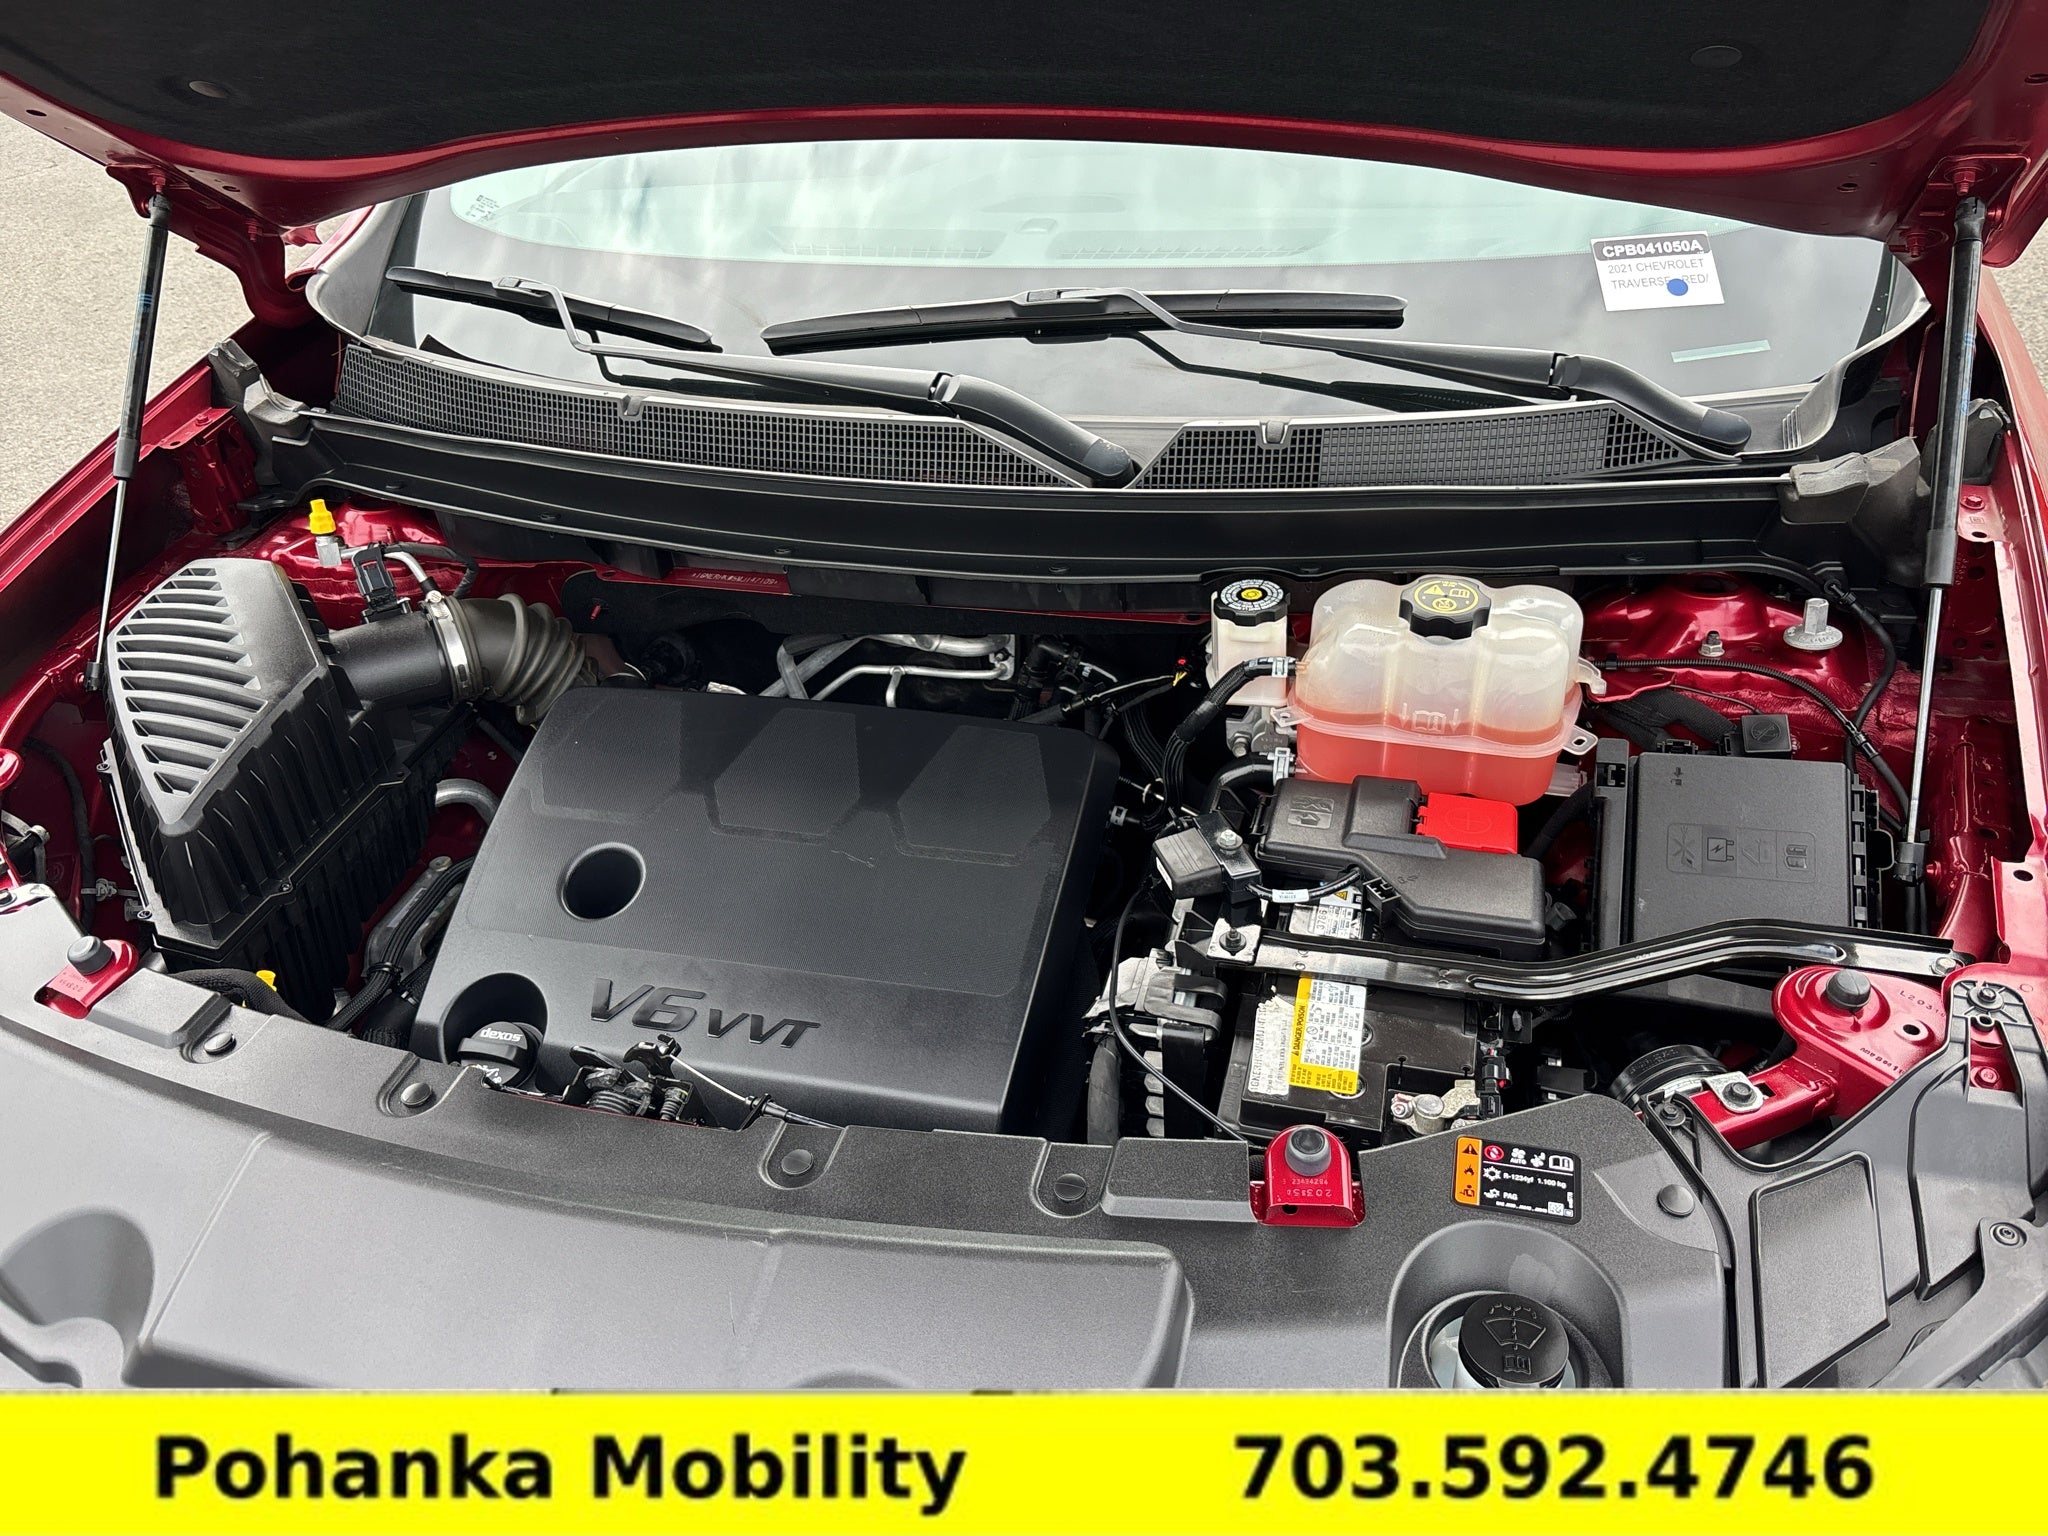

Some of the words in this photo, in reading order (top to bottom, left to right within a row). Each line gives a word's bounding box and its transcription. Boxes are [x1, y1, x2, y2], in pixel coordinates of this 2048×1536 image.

[1602, 239, 1704, 259] CPB041050A
[1608, 263, 1633, 274] 2021
[1635, 258, 1704, 273] CHEVROLET
[590, 978, 706, 1032] V6
[707, 1008, 821, 1049] VVT
[480, 1027, 524, 1042] dexos
[1503, 1191, 1519, 1201] PAG
